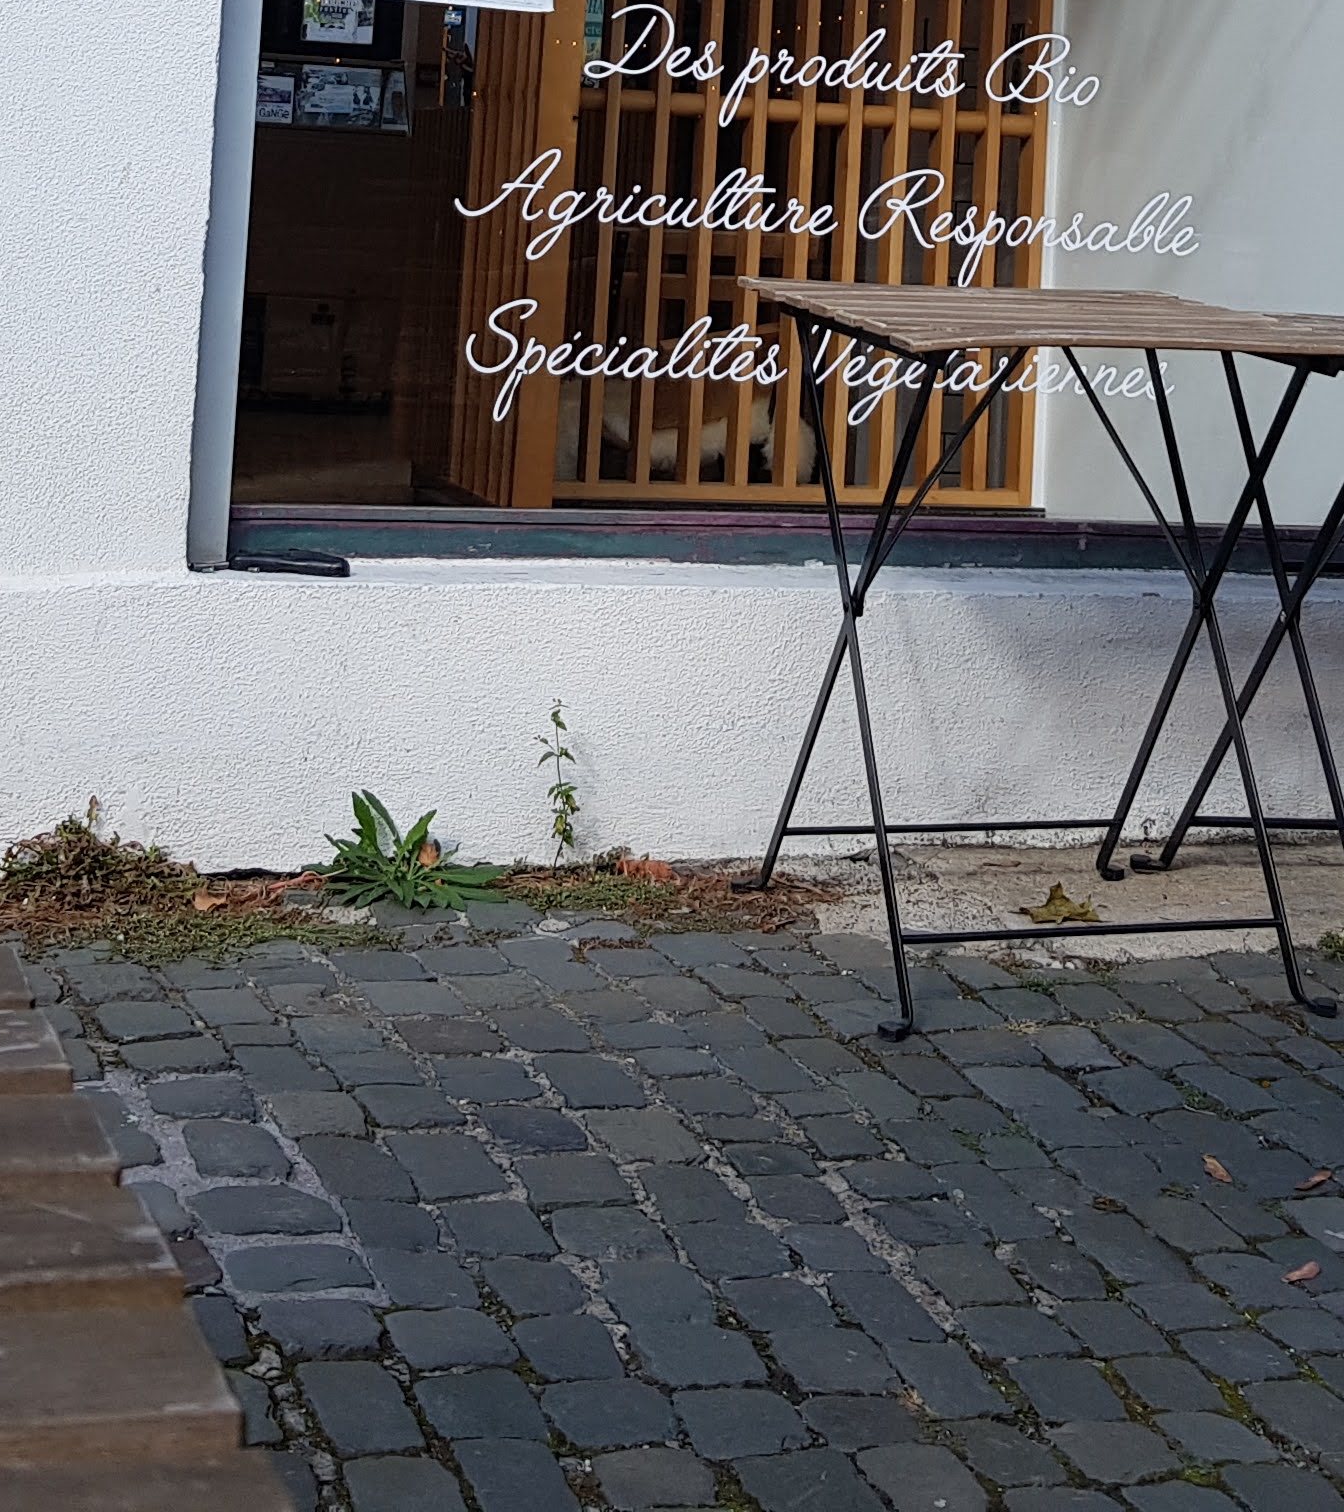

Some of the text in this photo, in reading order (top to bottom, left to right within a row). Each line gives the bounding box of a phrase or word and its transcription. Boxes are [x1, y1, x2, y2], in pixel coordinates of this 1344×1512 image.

[583, 3, 1101, 128] Des produits Bio
[453, 147, 1200, 289] Agriculture Responsable
[464, 297, 789, 423] Spécialités
